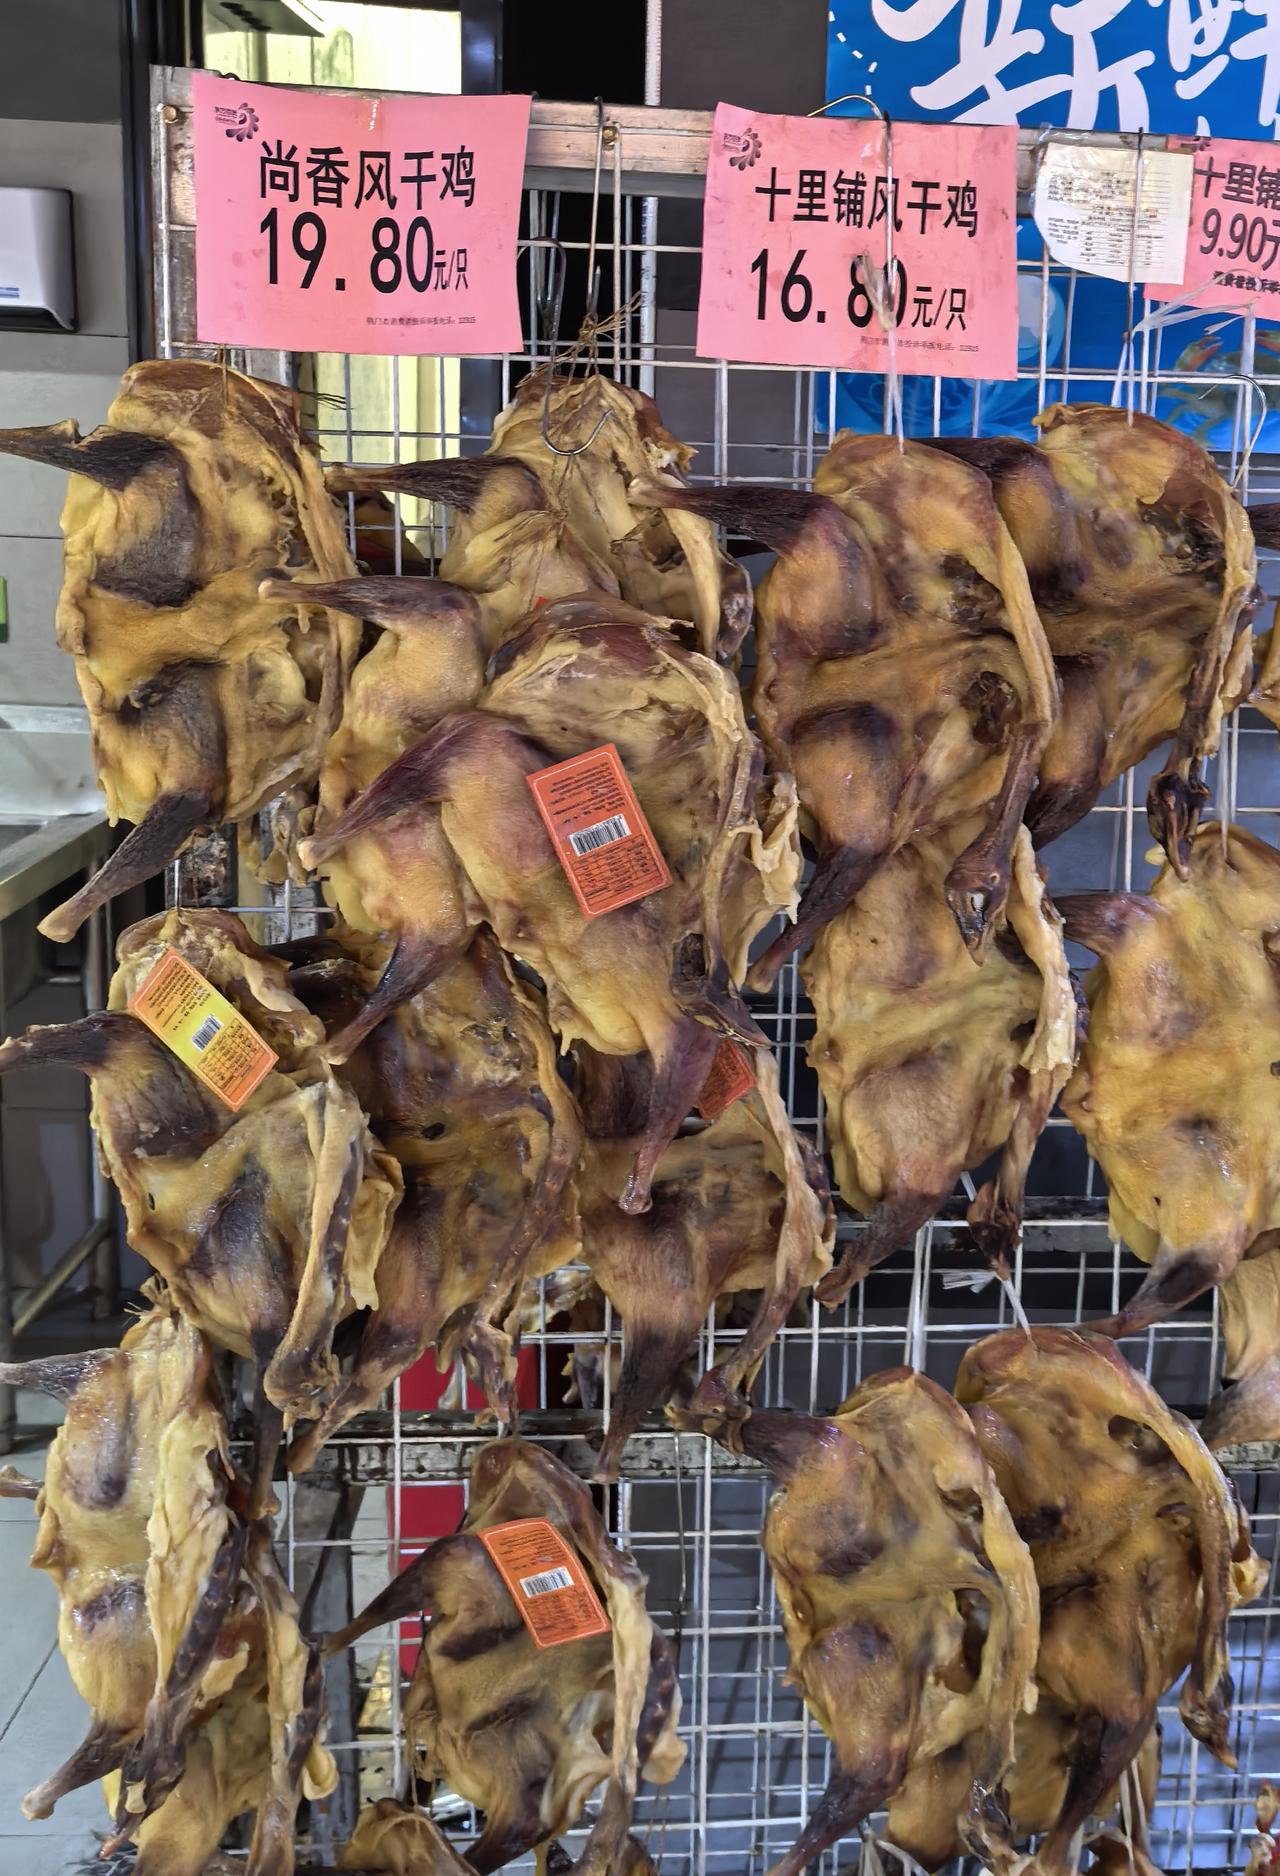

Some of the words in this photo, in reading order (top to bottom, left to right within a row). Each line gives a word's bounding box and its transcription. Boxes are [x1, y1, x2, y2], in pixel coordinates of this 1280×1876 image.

[259, 140, 475, 209] 尚香风干鸡
[755, 167, 979, 237] 十里铺风干鸡
